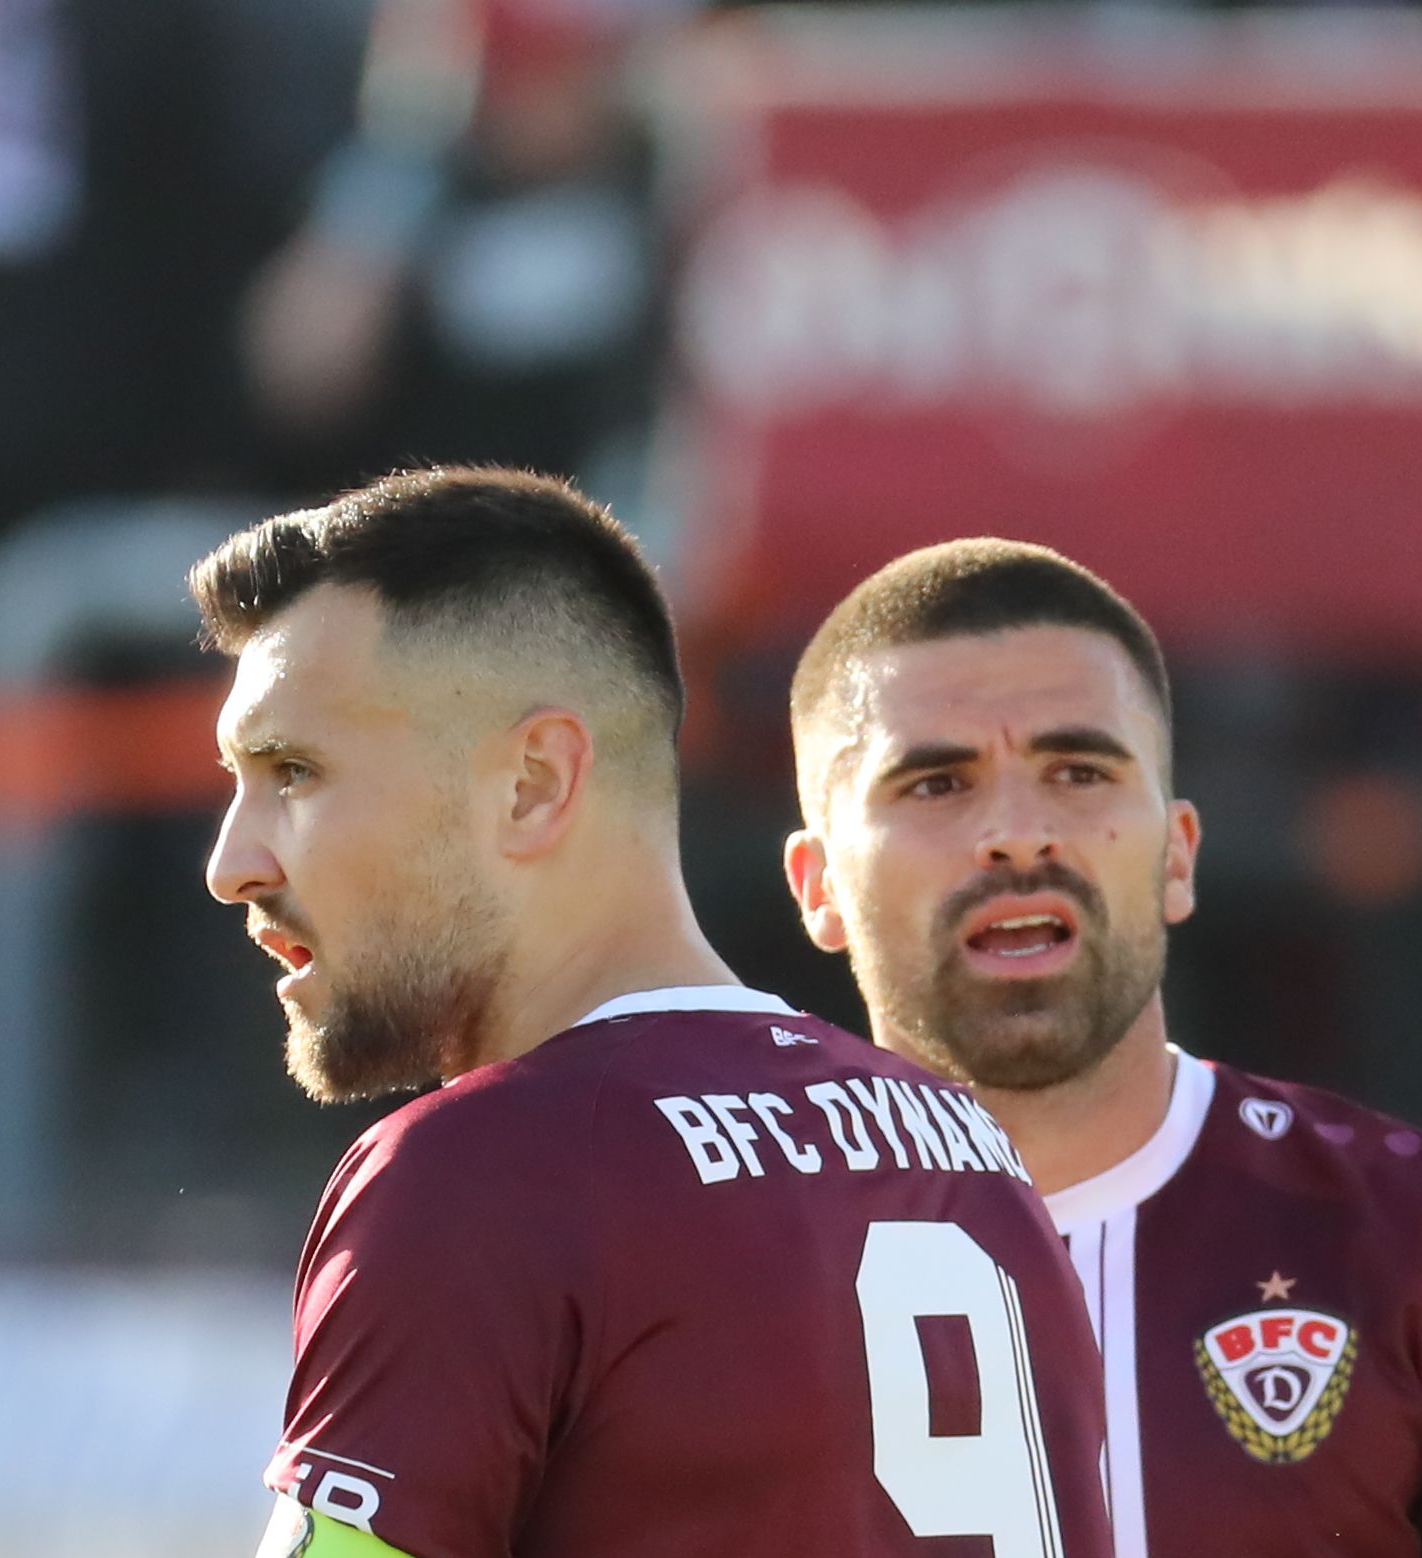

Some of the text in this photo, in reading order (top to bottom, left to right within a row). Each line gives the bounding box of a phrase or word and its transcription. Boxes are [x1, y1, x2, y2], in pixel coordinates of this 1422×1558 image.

[654, 1092, 822, 1184] BFC
[1215, 1316, 1338, 1363] BFC
[1254, 1367, 1303, 1412] D
